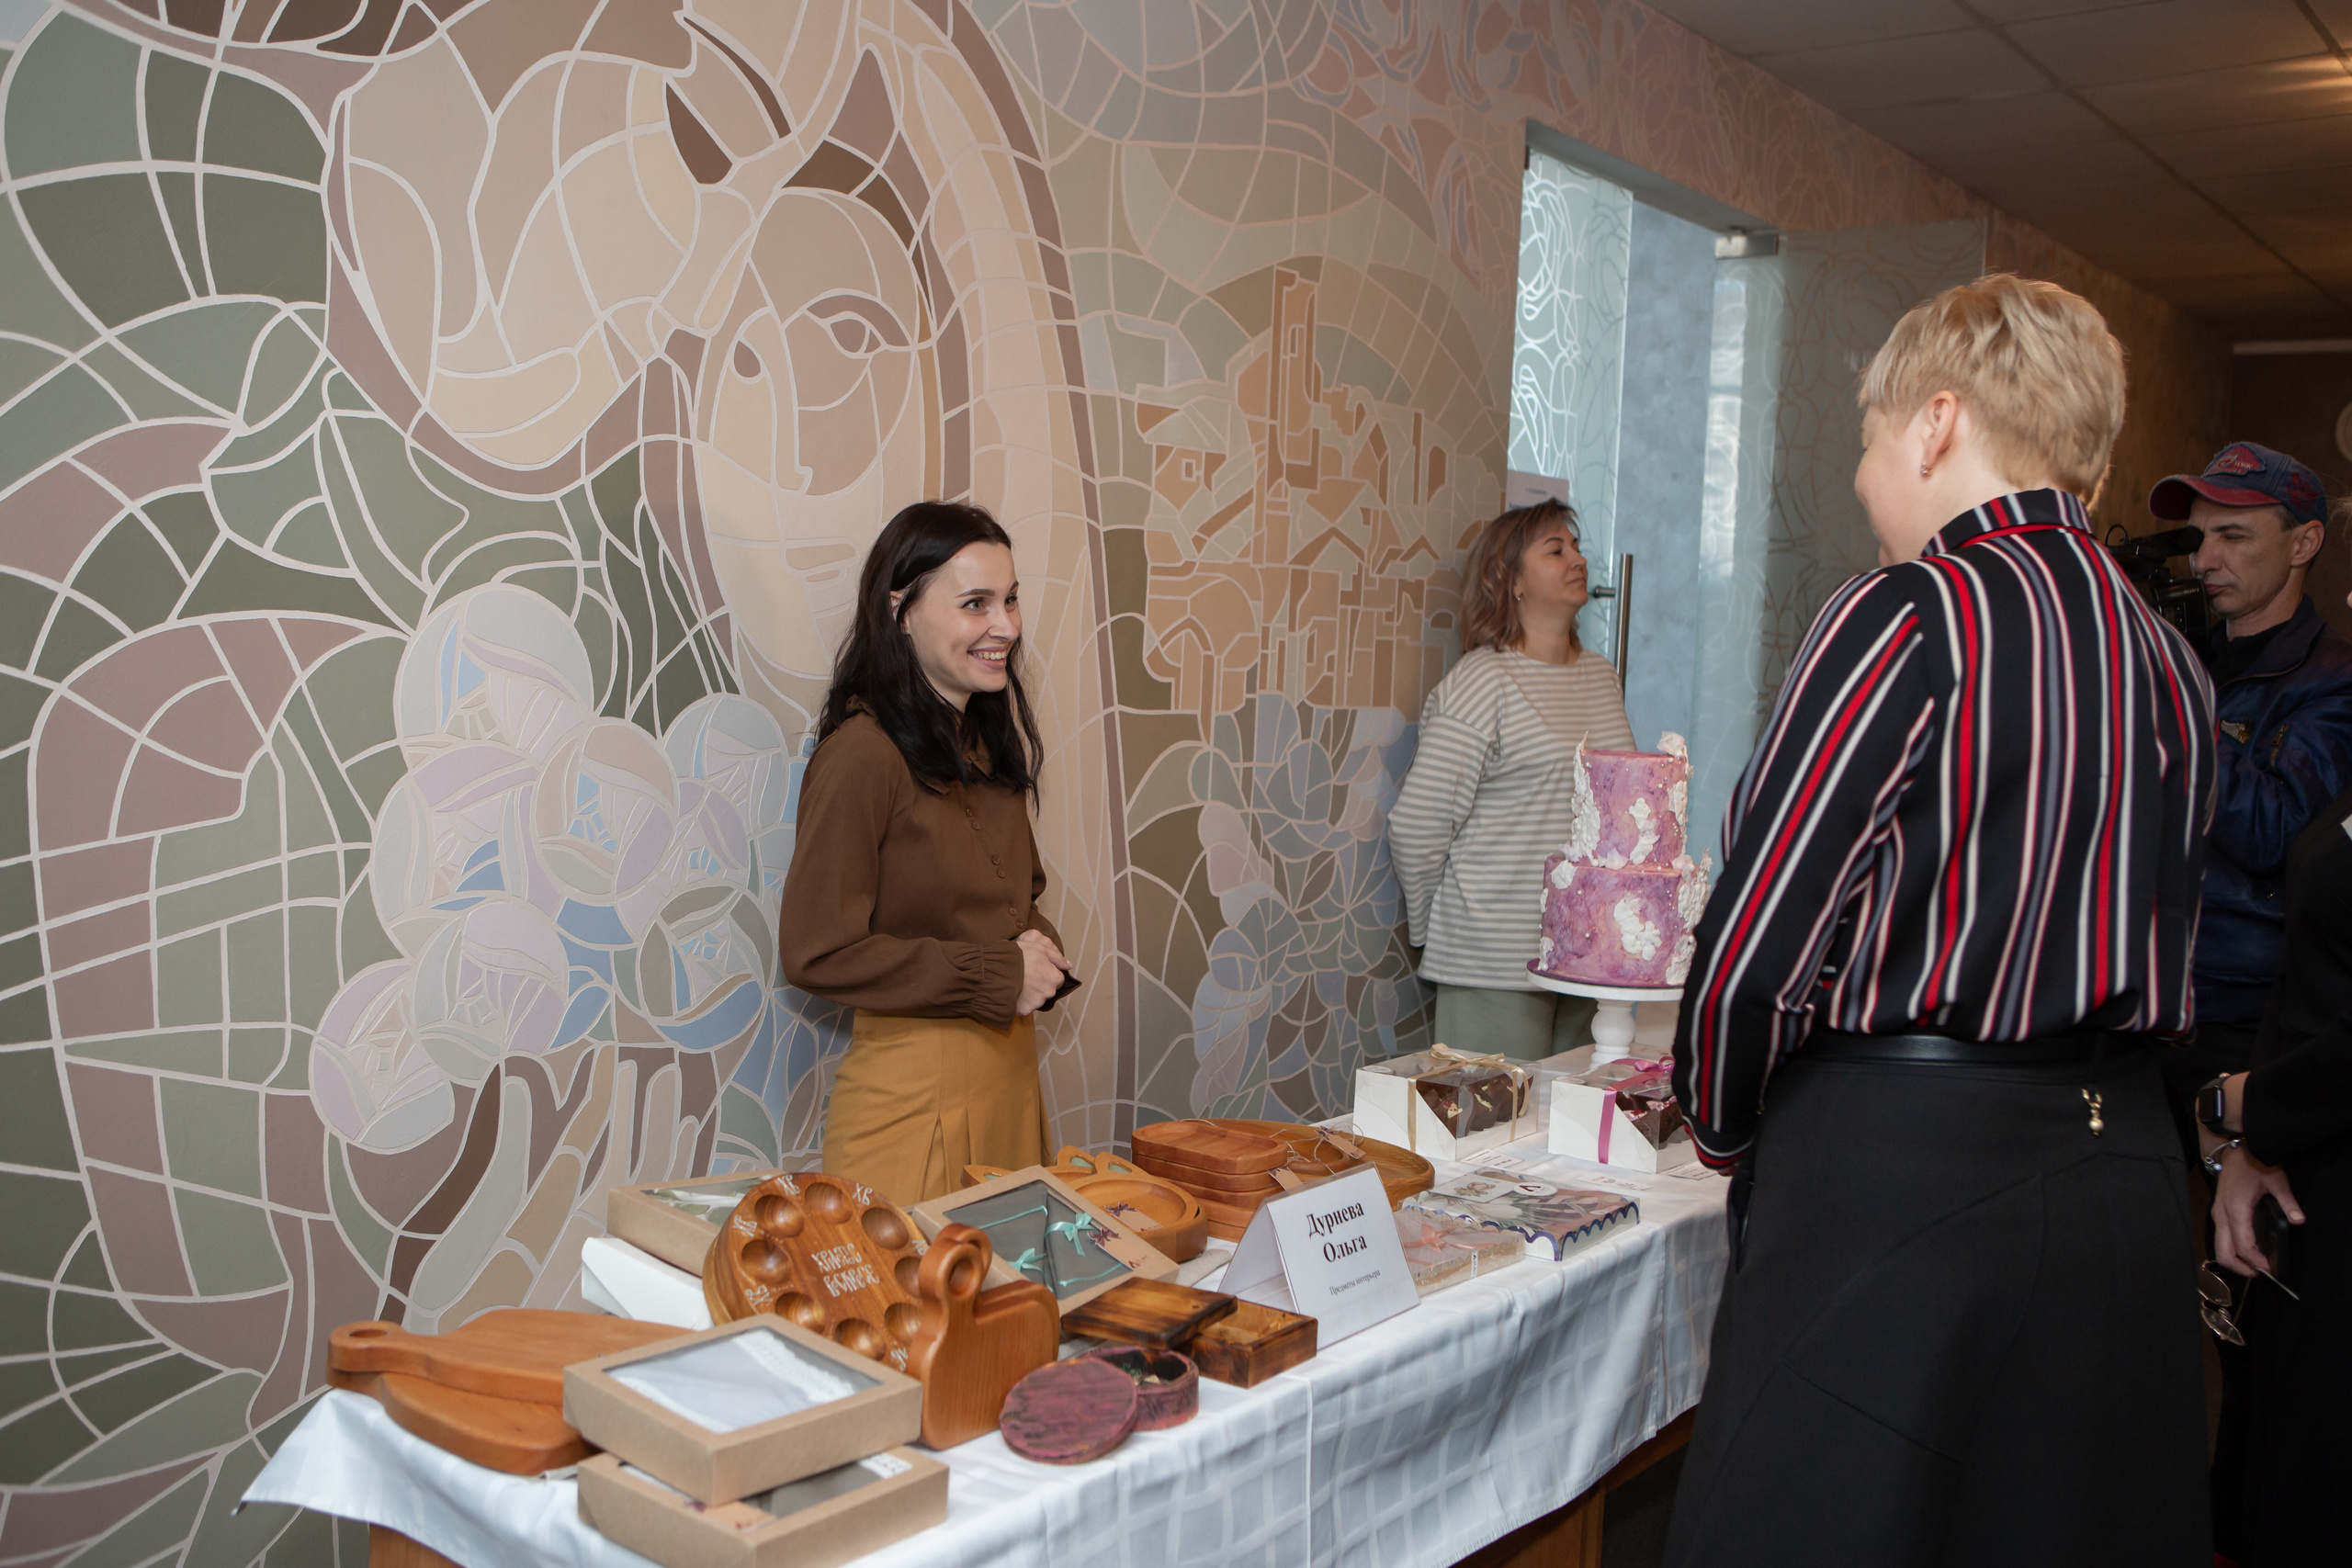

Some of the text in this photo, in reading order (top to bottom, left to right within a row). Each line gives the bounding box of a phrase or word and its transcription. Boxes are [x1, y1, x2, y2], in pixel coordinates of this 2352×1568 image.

[853, 1182, 873, 1206] ХВ
[1306, 1202, 1365, 1241] Дурнева
[1323, 1235, 1368, 1263] Ольга
[1329, 1269, 1381, 1296] Предметы интерьера
